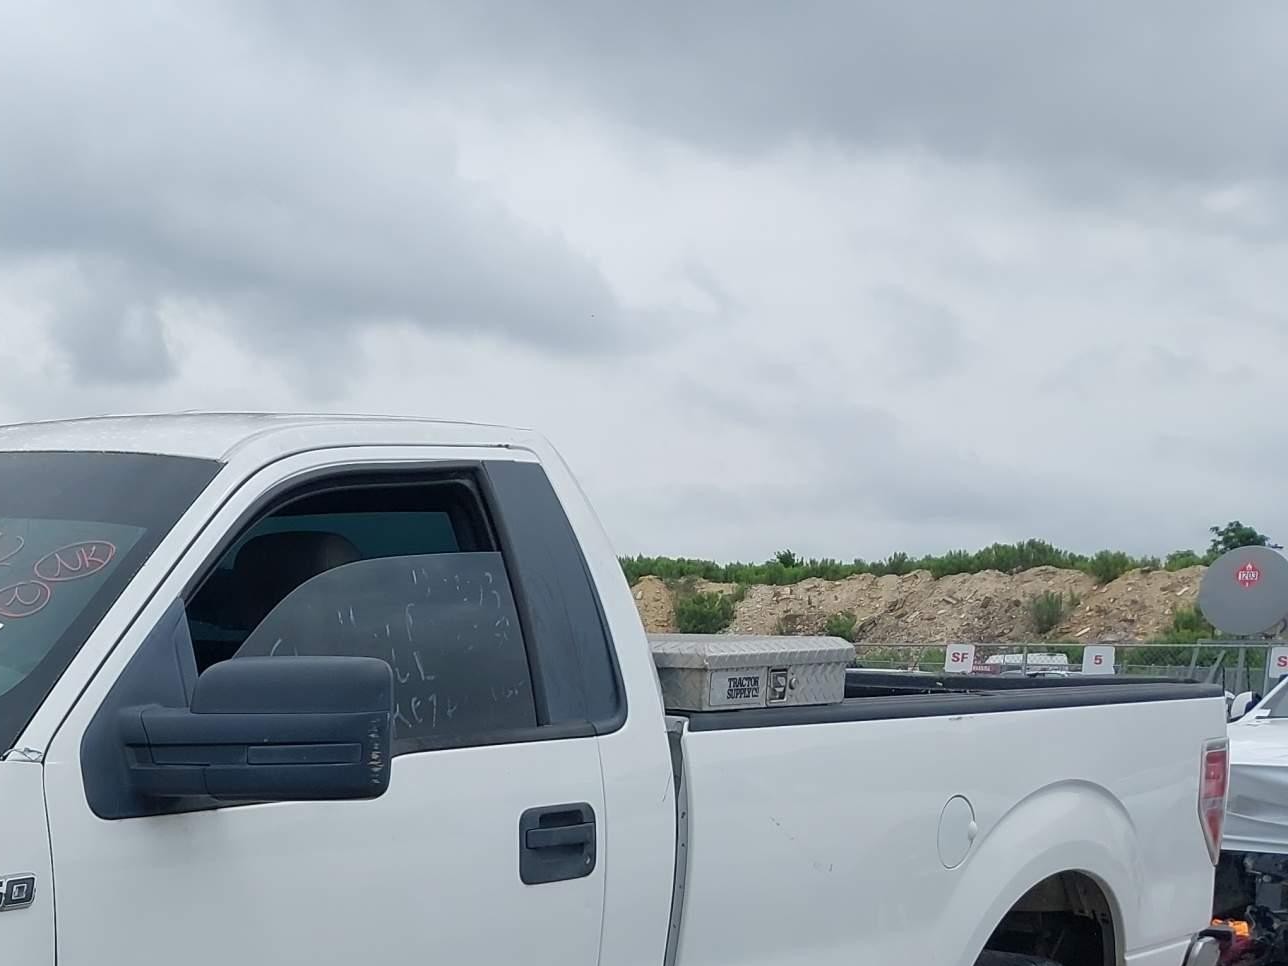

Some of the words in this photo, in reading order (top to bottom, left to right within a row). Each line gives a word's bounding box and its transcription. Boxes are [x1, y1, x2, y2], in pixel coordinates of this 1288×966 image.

[951, 652, 968, 662] SF
[1094, 655, 1103, 664] 5
[727, 676, 759, 688] TRACTOR
[727, 688, 751, 699] SUPPLY
